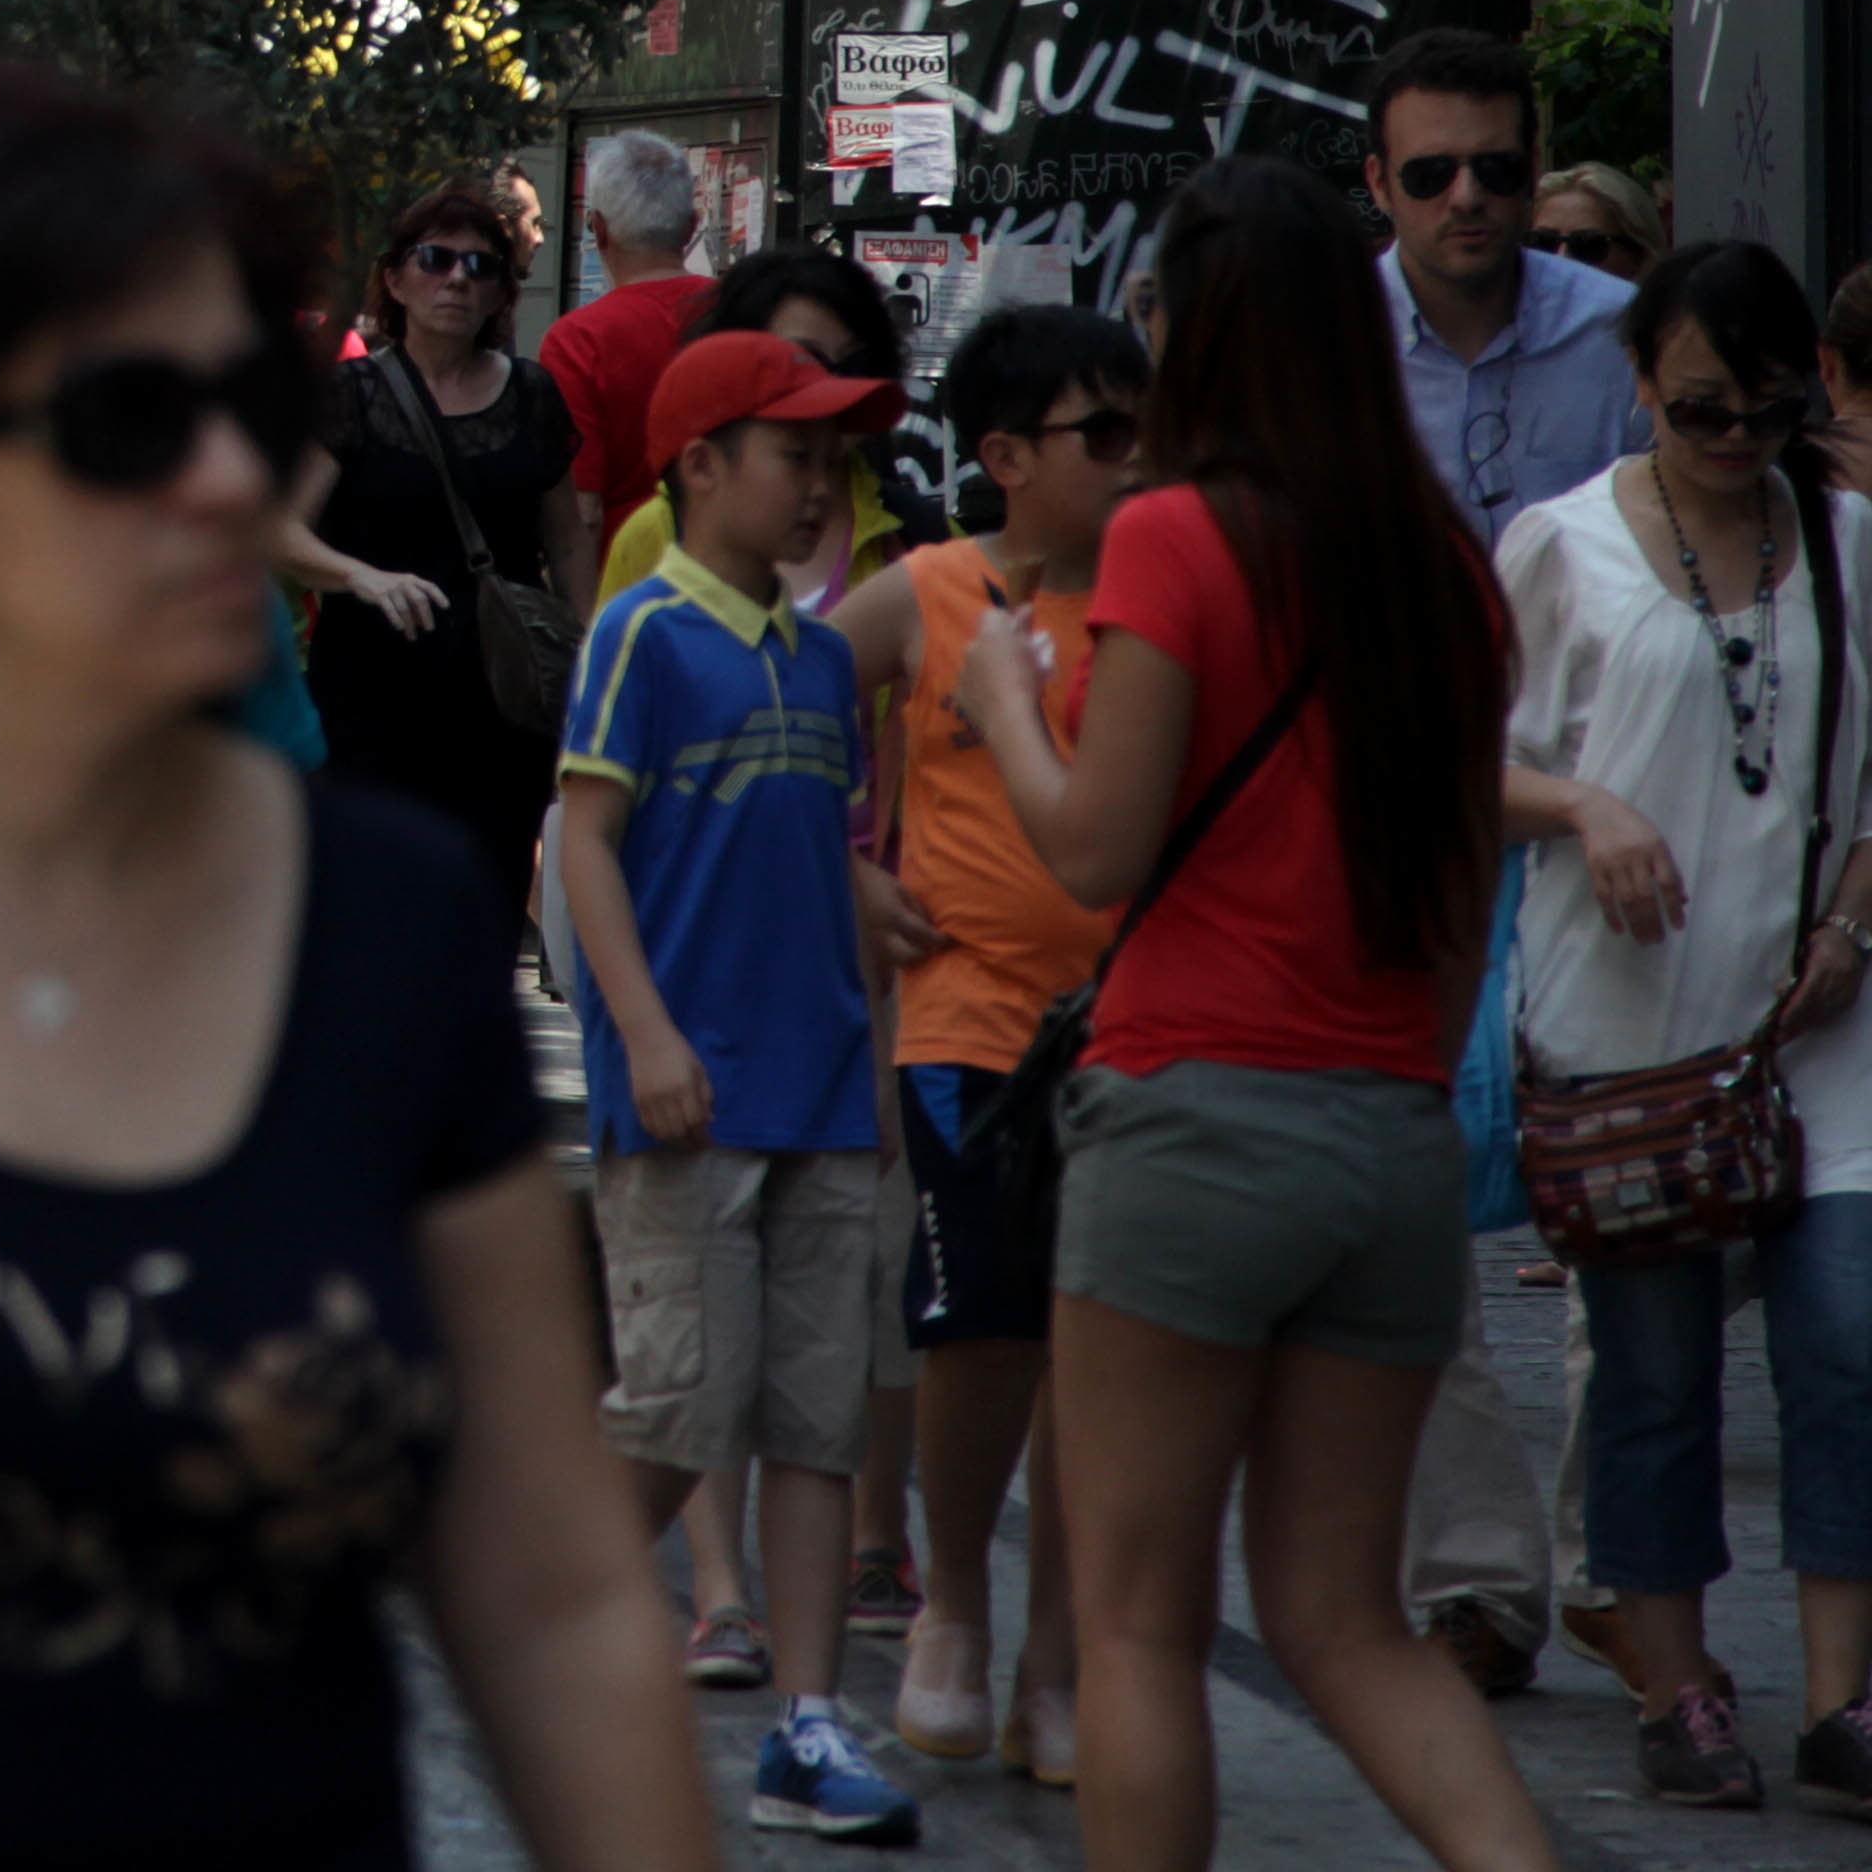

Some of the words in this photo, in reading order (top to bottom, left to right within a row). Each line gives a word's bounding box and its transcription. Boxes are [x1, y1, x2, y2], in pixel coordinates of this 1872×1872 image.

[841, 45, 946, 81] Βάφω
[835, 116, 894, 139] Βάφ
[865, 240, 947, 258] ΕΞΑΦΑΝΙΣΗ
